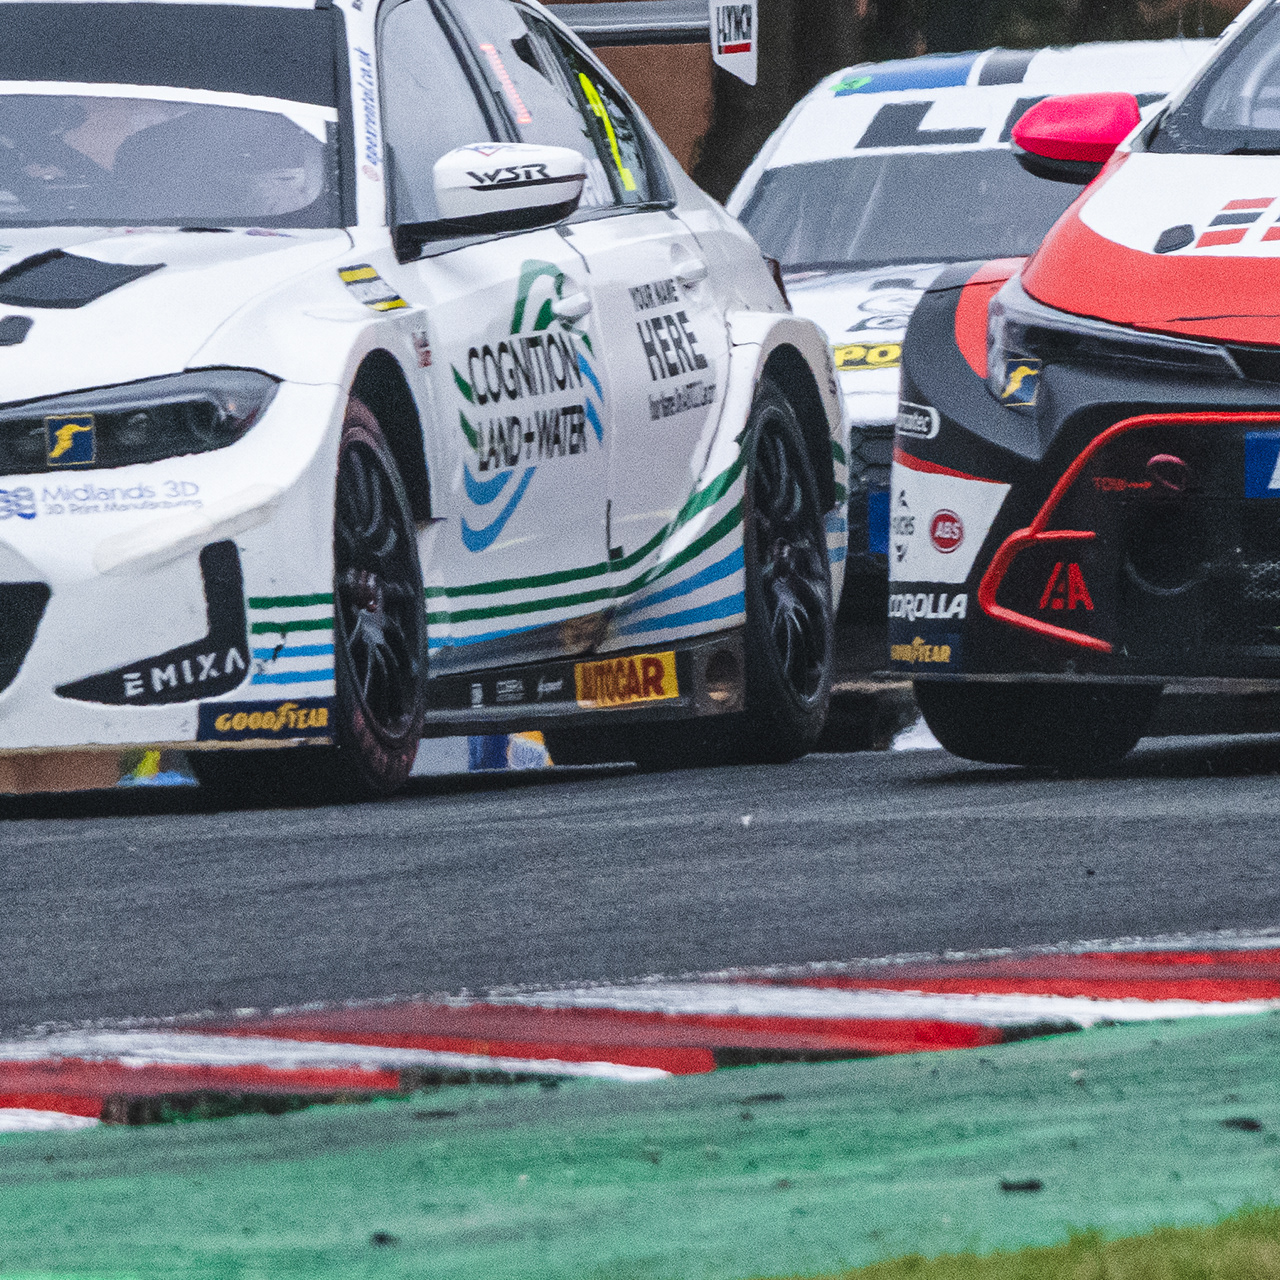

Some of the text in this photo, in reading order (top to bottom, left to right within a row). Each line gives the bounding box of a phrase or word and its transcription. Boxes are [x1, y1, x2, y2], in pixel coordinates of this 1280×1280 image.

[466, 162, 552, 184] WSR
[636, 310, 709, 382] HERE
[468, 332, 584, 406] COGNITION
[42, 480, 200, 502] Midlands 3D
[935, 521, 961, 541] ABS
[123, 647, 247, 697] EMIXA
[214, 702, 329, 732] GOODYEAR
